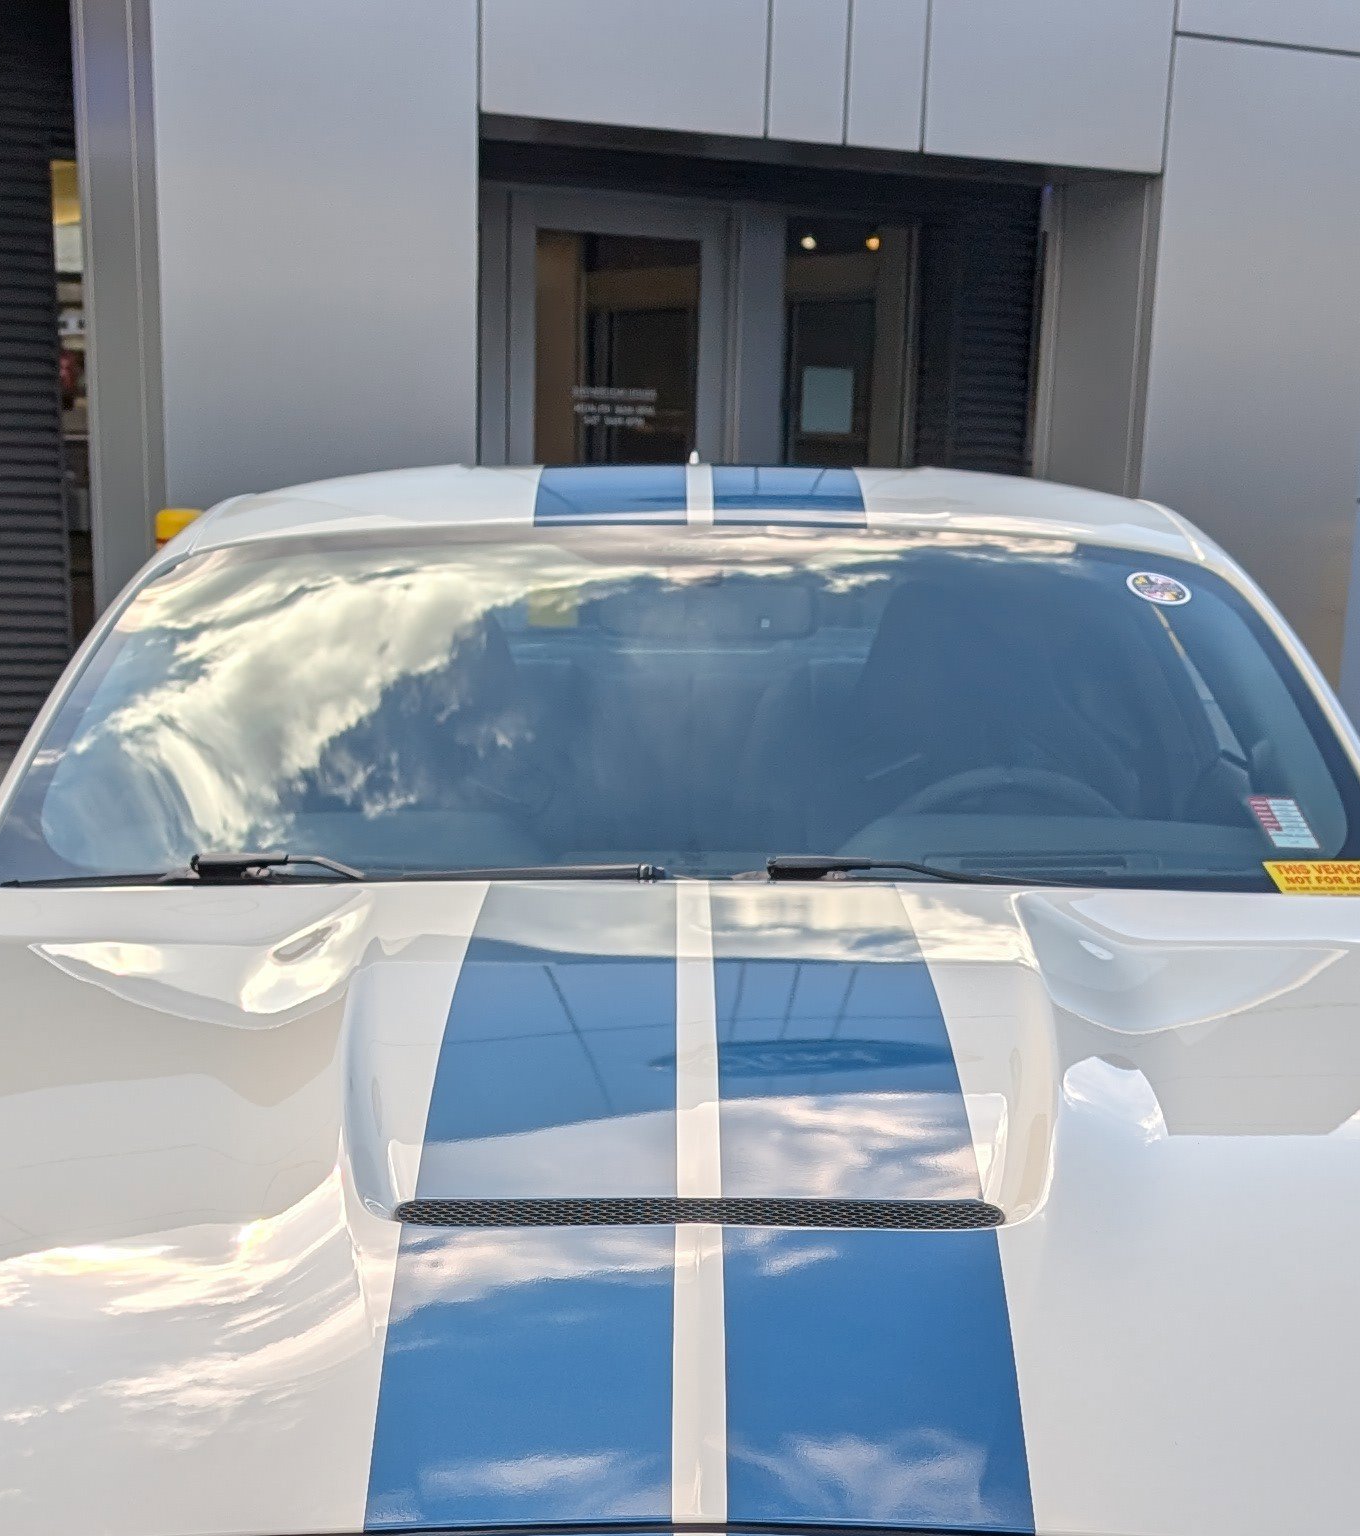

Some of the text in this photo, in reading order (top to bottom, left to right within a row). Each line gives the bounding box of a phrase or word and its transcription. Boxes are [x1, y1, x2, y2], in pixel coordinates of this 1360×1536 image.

[1273, 864, 1311, 875] THIS
[1283, 876, 1312, 885] NOT
[1315, 876, 1344, 885] FOR
